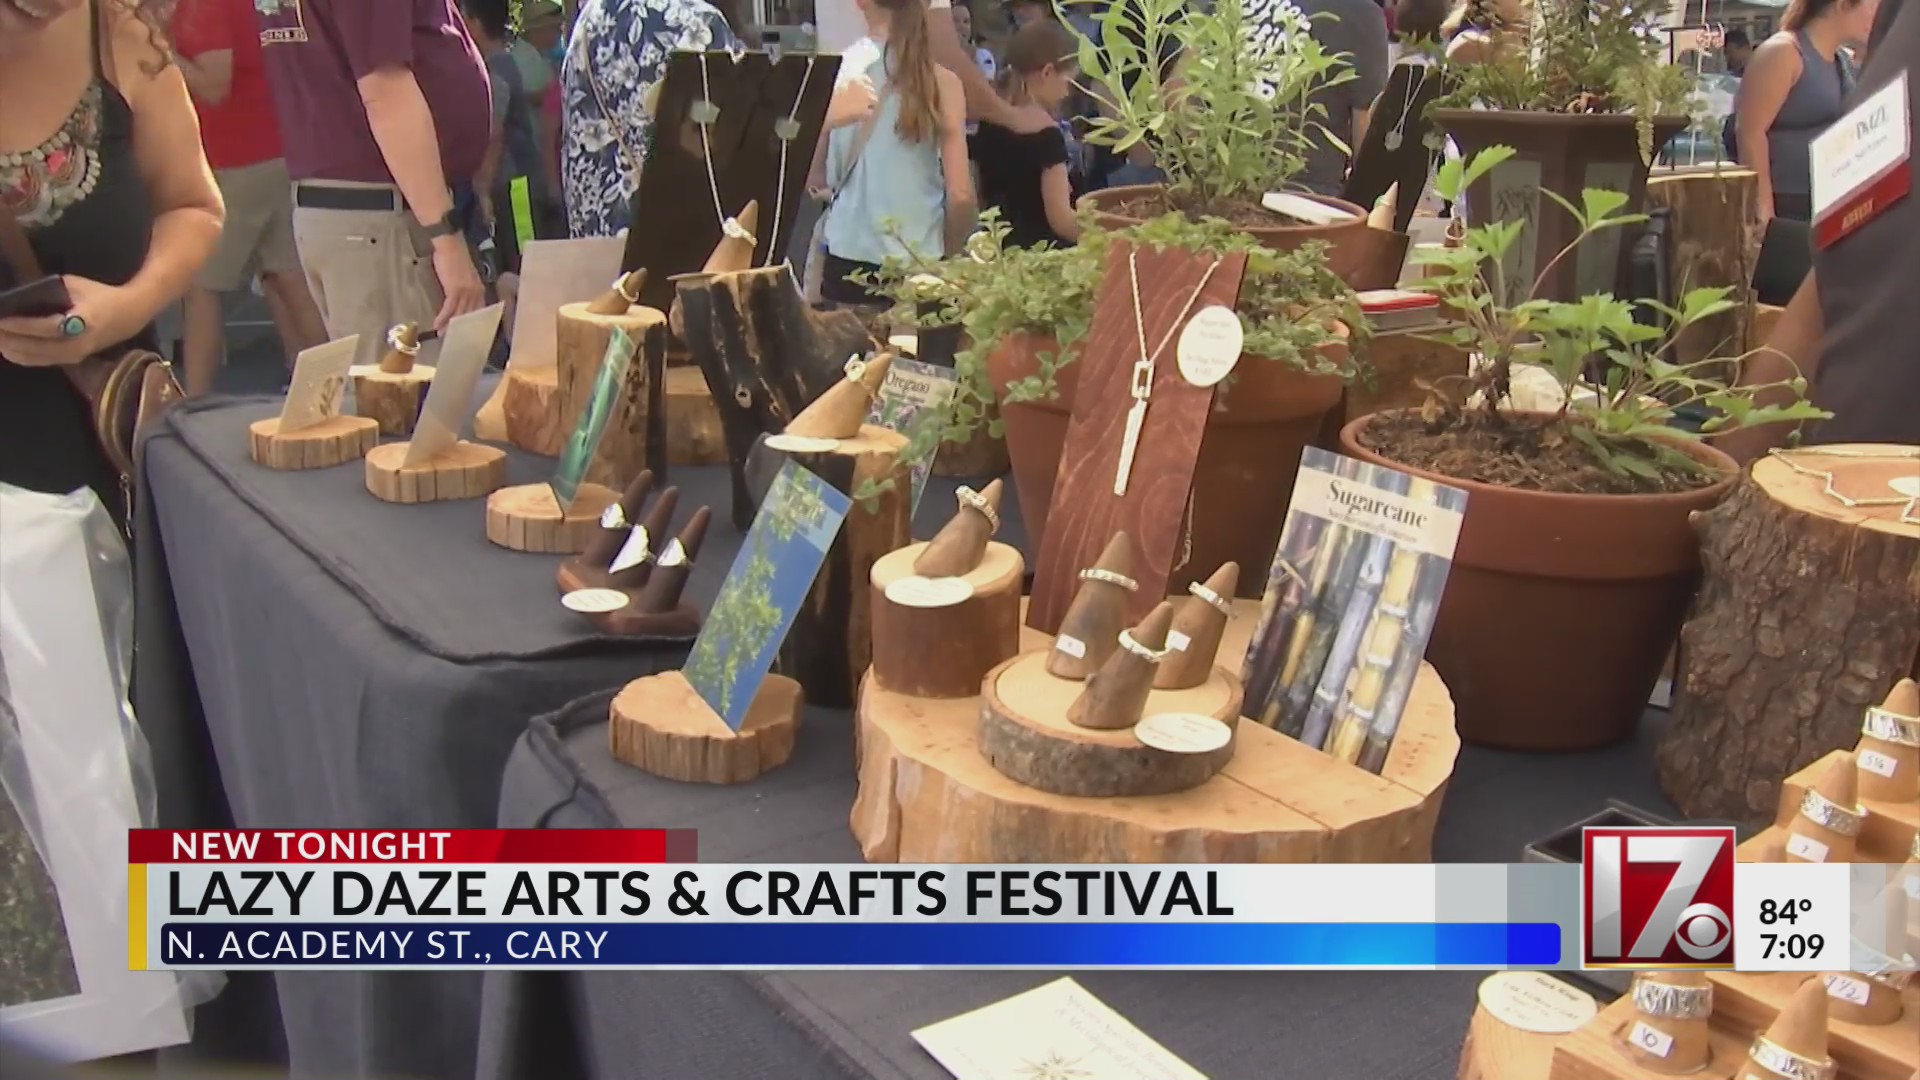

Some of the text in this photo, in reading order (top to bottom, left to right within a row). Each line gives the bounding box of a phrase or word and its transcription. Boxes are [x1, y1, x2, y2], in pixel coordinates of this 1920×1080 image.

[885, 371, 931, 394] Oregano
[1326, 478, 1429, 530] Sugarcane
[1641, 1026, 1659, 1049] 10
